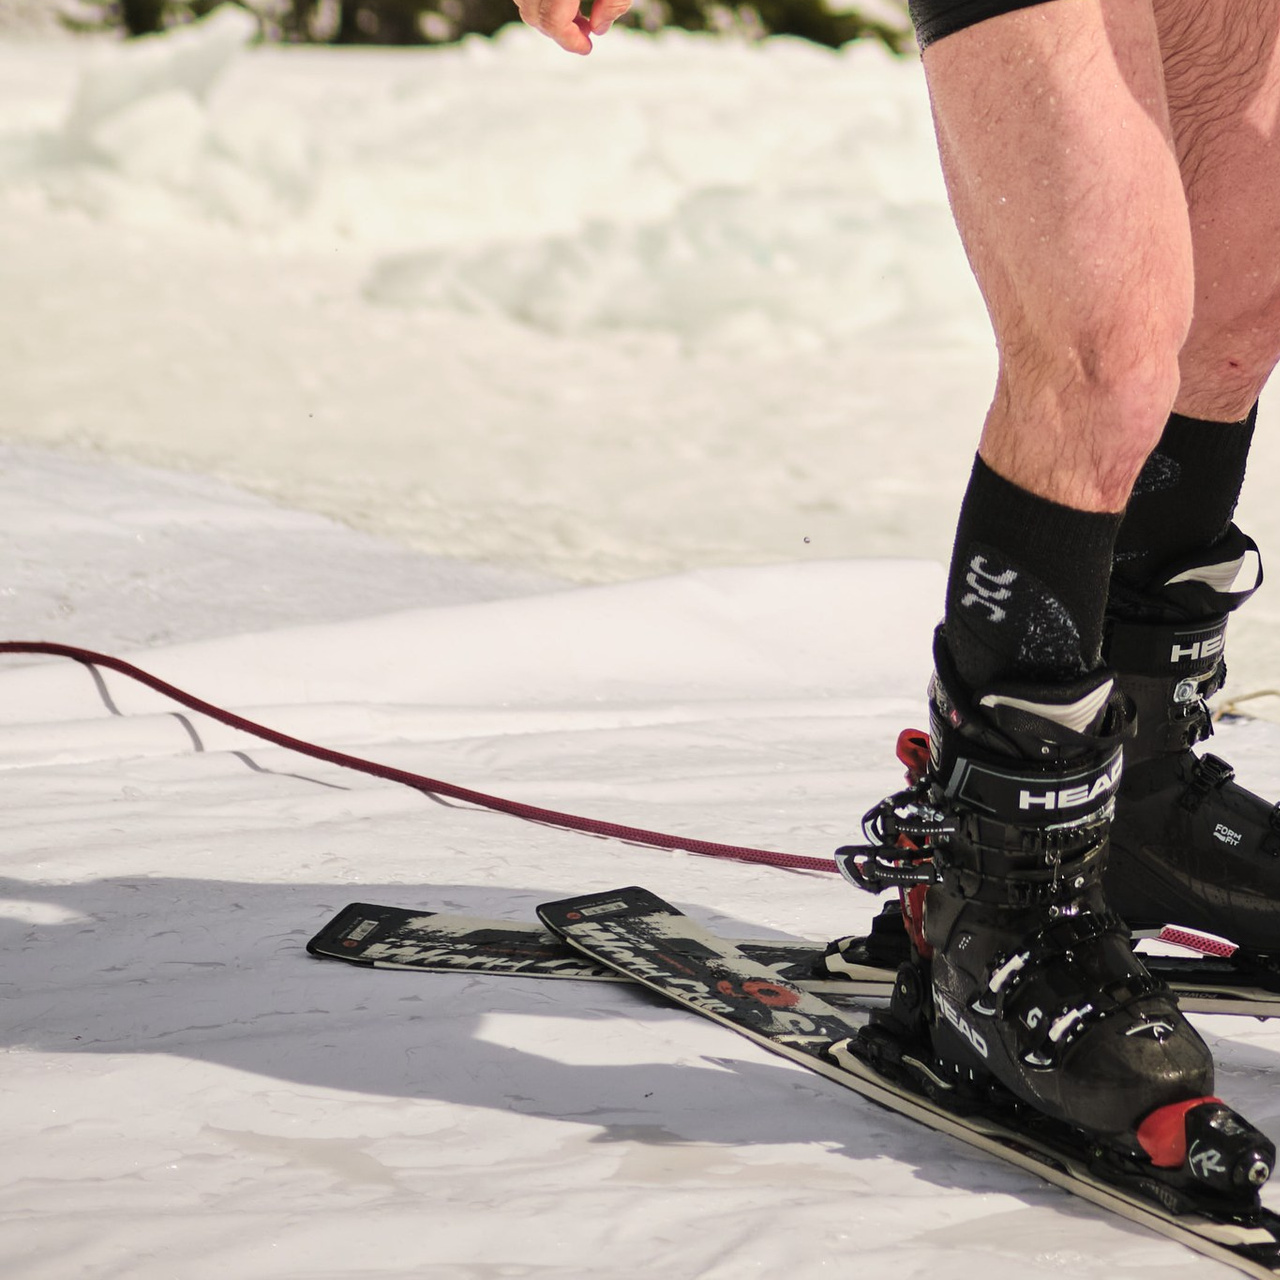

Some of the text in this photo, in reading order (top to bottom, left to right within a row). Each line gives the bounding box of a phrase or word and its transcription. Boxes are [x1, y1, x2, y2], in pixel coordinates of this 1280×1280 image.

[1170, 634, 1225, 663] HE
[1019, 751, 1123, 810] HEAD
[1214, 823, 1242, 841] FORM
[1225, 836, 1240, 846] FIT
